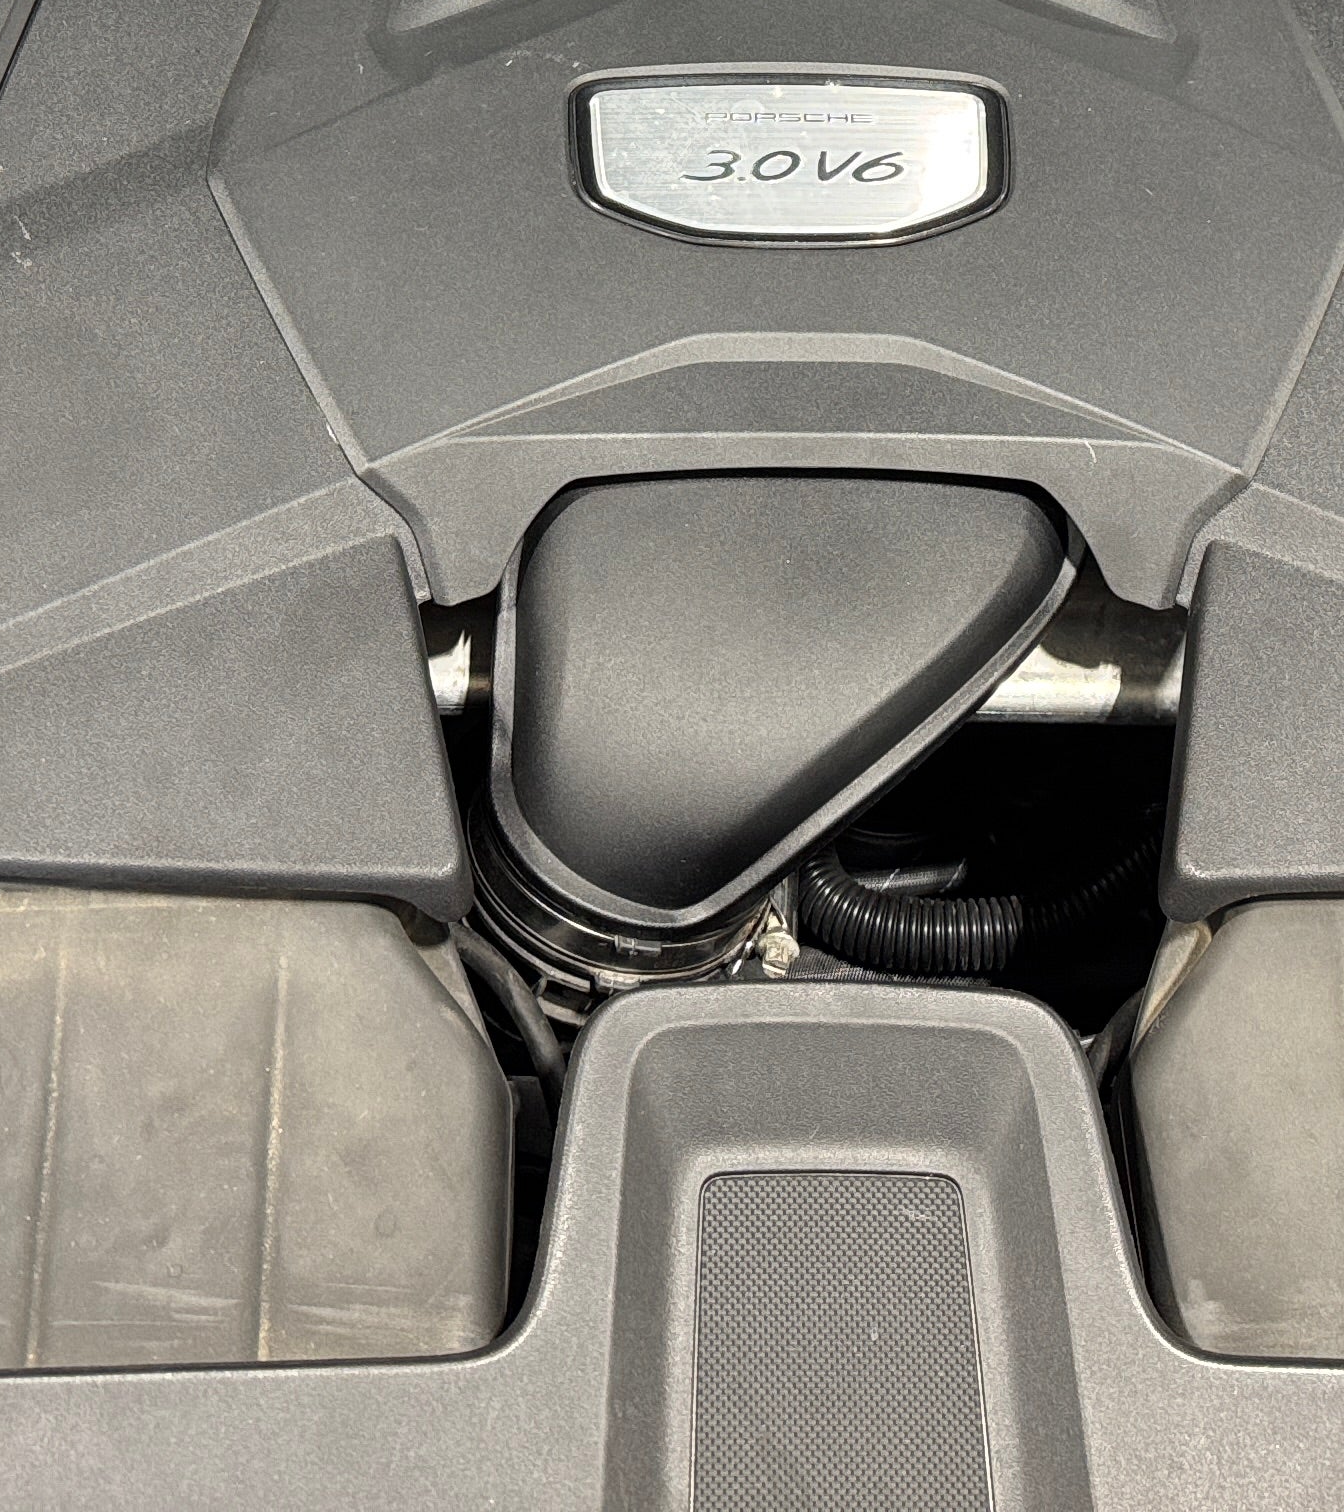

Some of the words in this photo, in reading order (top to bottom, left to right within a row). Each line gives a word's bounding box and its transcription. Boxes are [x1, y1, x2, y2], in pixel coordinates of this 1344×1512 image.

[704, 112, 873, 124] PORSCHE
[679, 149, 801, 181] 3.0
[816, 150, 905, 182] V6
